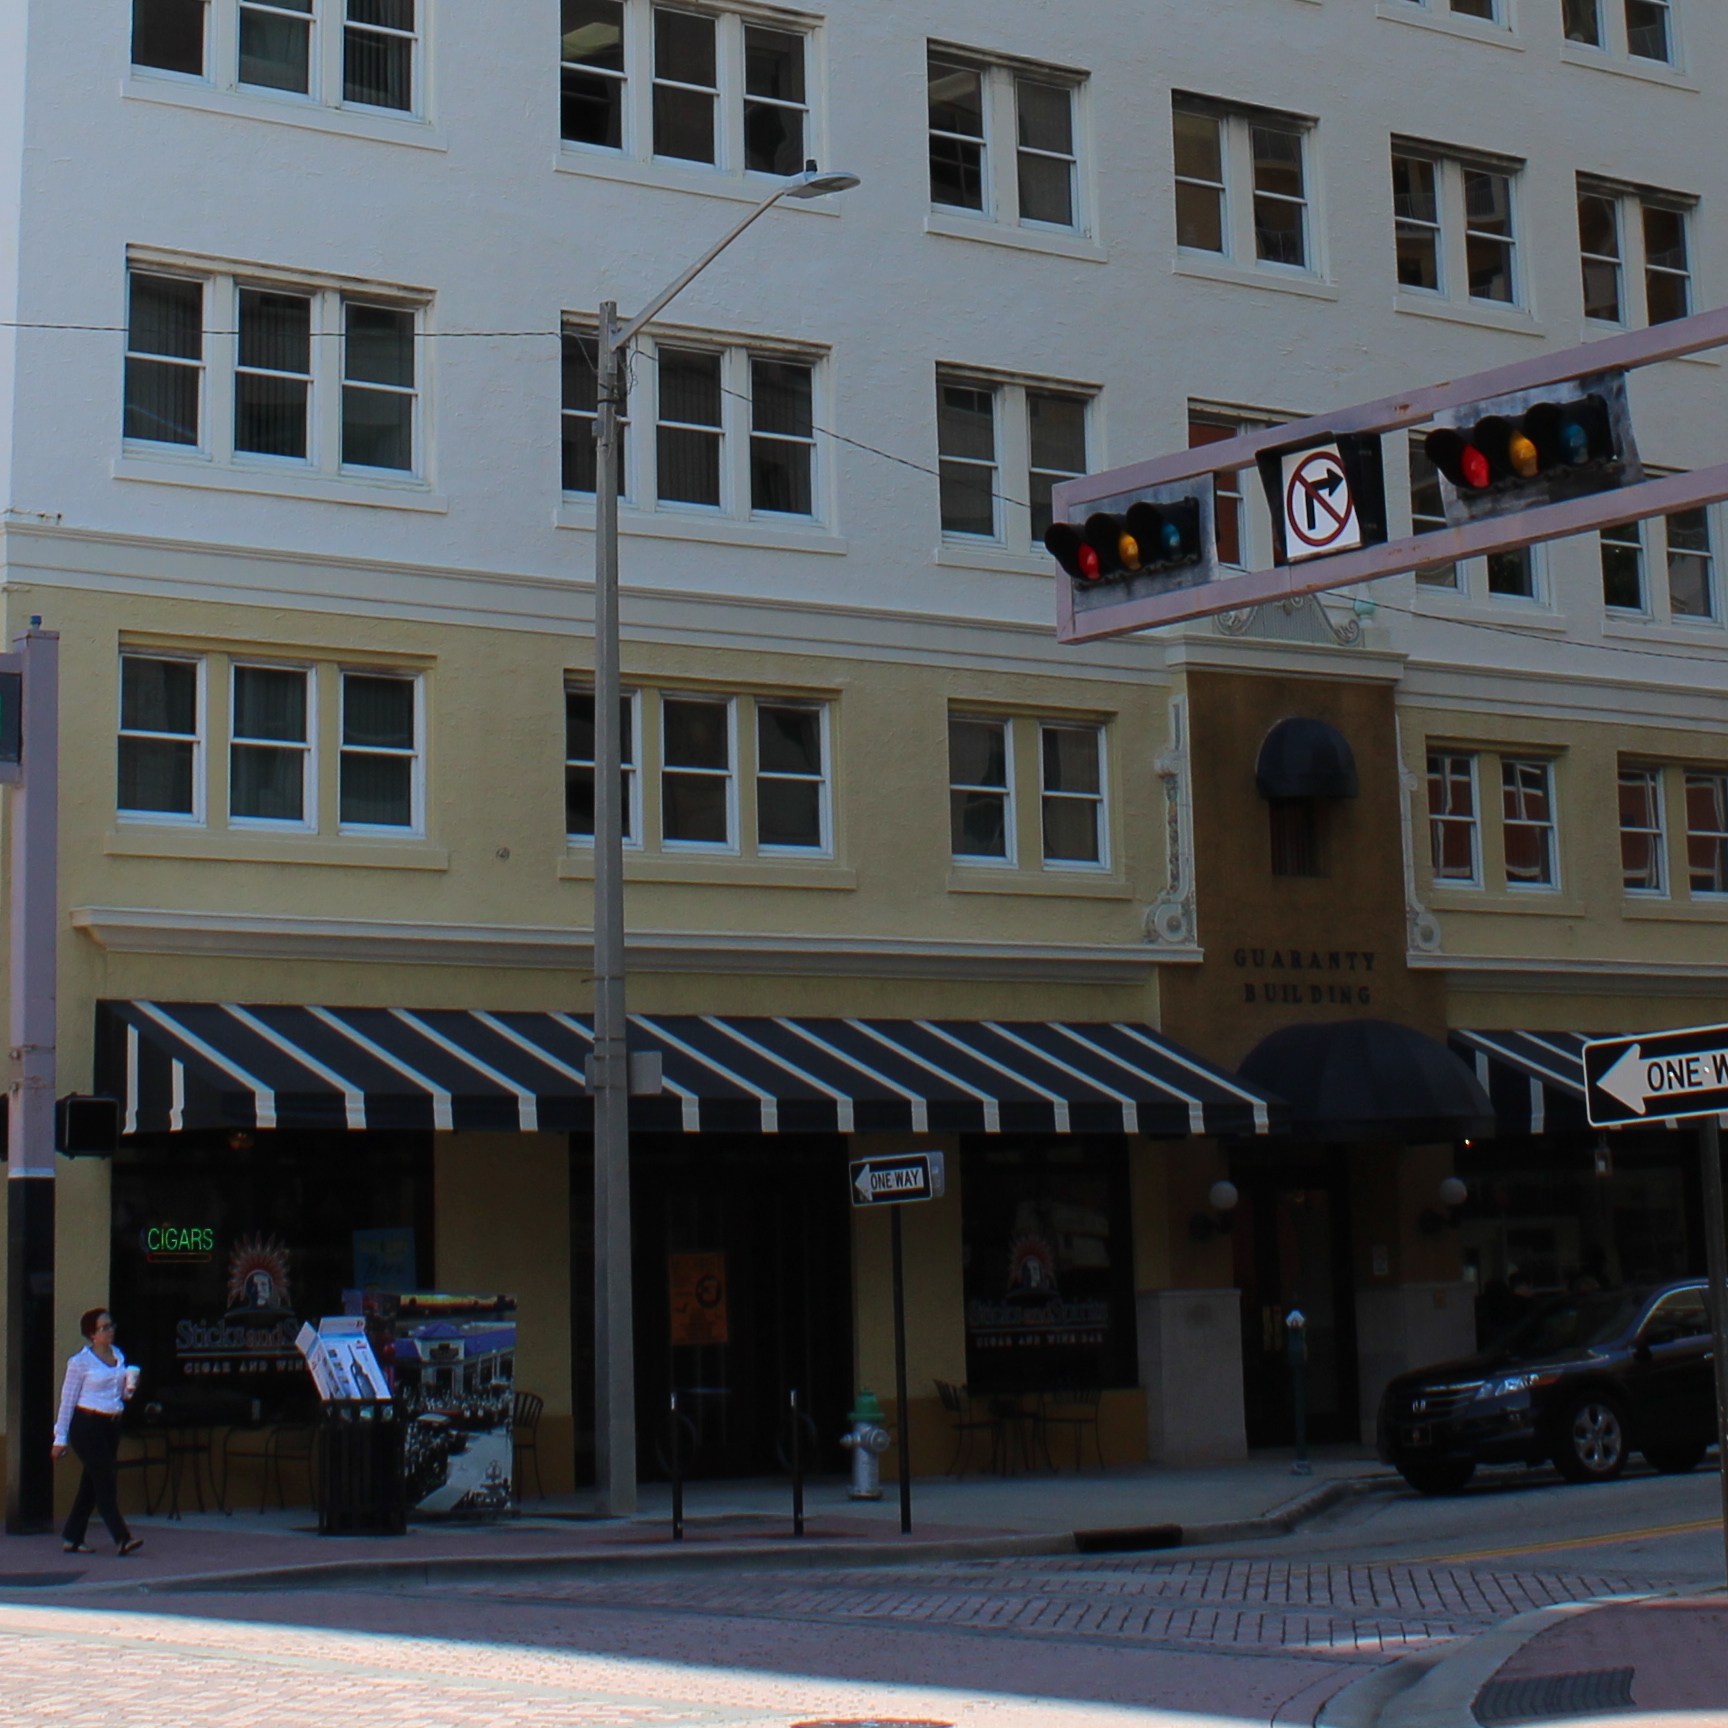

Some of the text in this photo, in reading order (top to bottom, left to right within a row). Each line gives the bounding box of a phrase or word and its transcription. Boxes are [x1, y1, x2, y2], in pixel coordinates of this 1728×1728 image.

[1233, 948, 1375, 971] GUARANTY
[1244, 983, 1371, 1005] BUILDING
[1647, 1057, 1703, 1092] ONE
[870, 1169, 919, 1190] ONE WAY
[147, 1227, 214, 1251] CIGARS
[183, 1359, 308, 1374] CIGAR AND WIN
